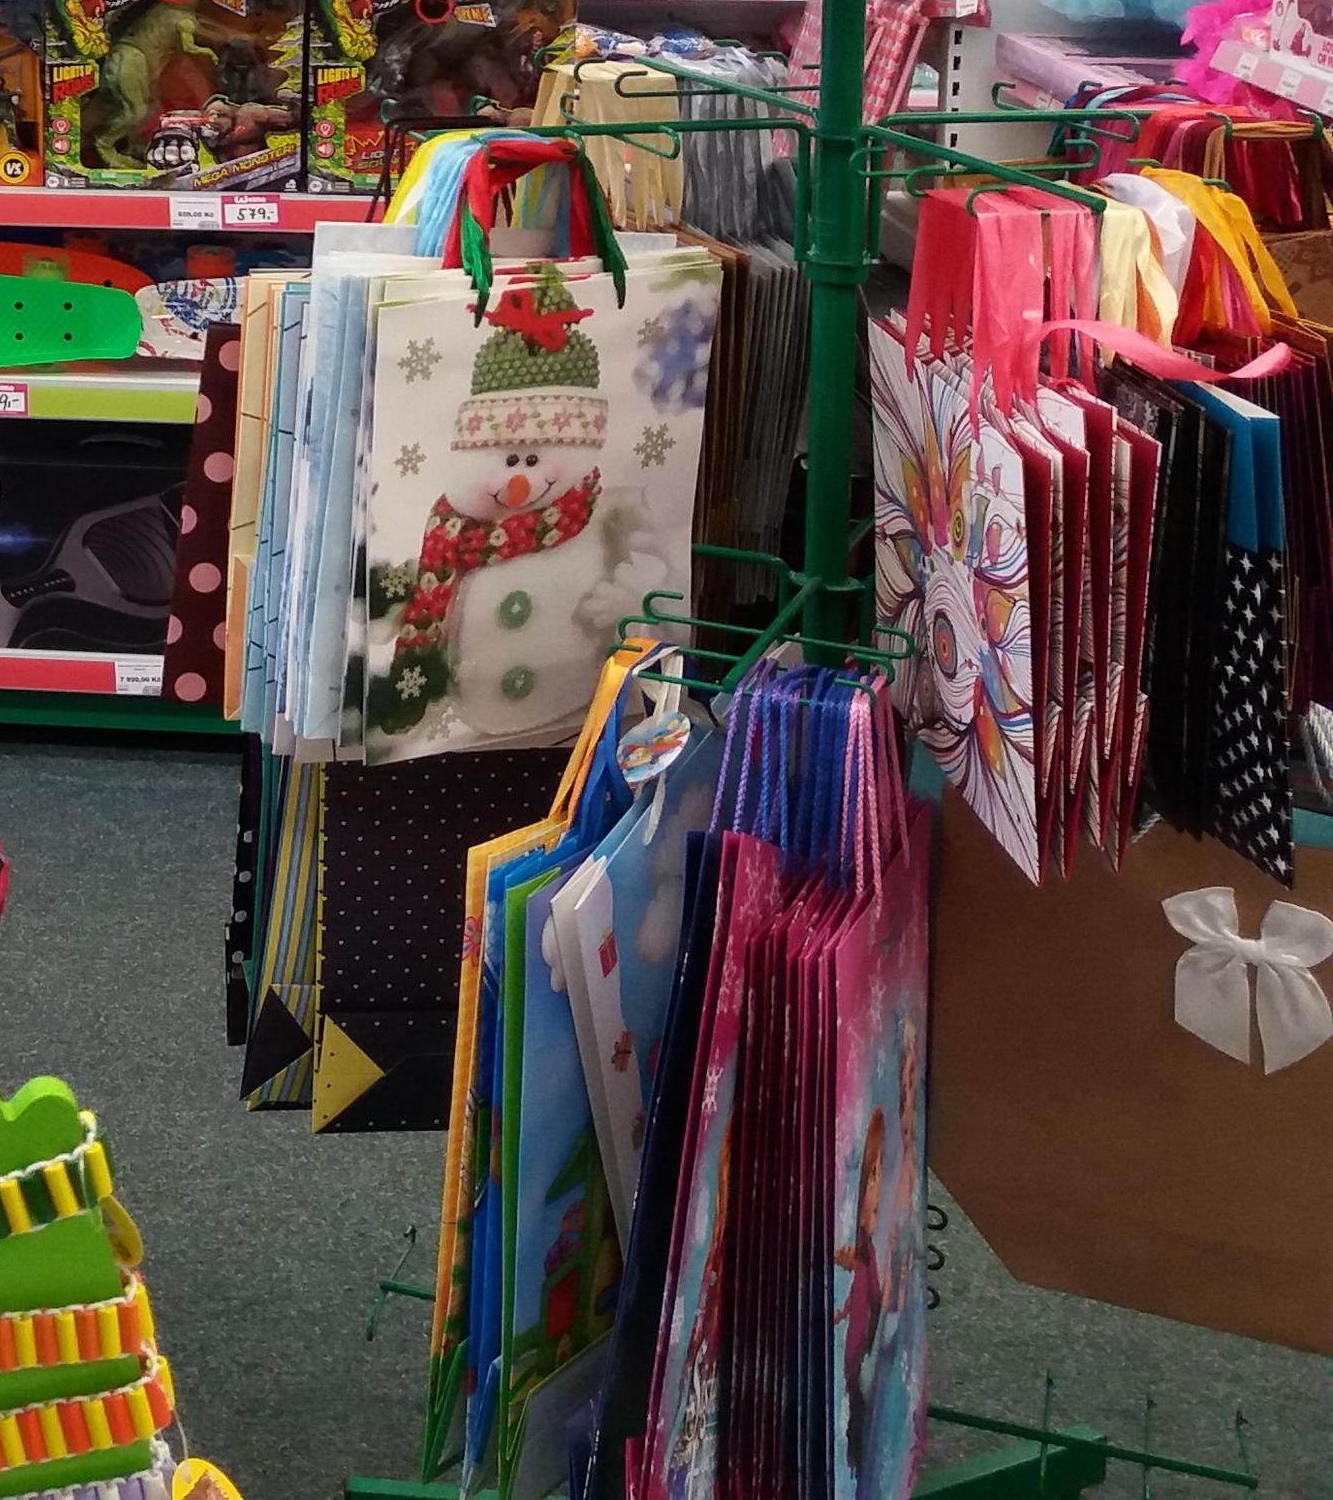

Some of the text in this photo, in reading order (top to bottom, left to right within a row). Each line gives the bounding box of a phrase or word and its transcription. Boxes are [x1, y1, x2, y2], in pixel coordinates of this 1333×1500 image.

[52, 65, 80, 82] LIGHTS
[317, 67, 345, 84] LIGHTS
[5, 160, 23, 176] VS
[193, 161, 232, 188] MEGA
